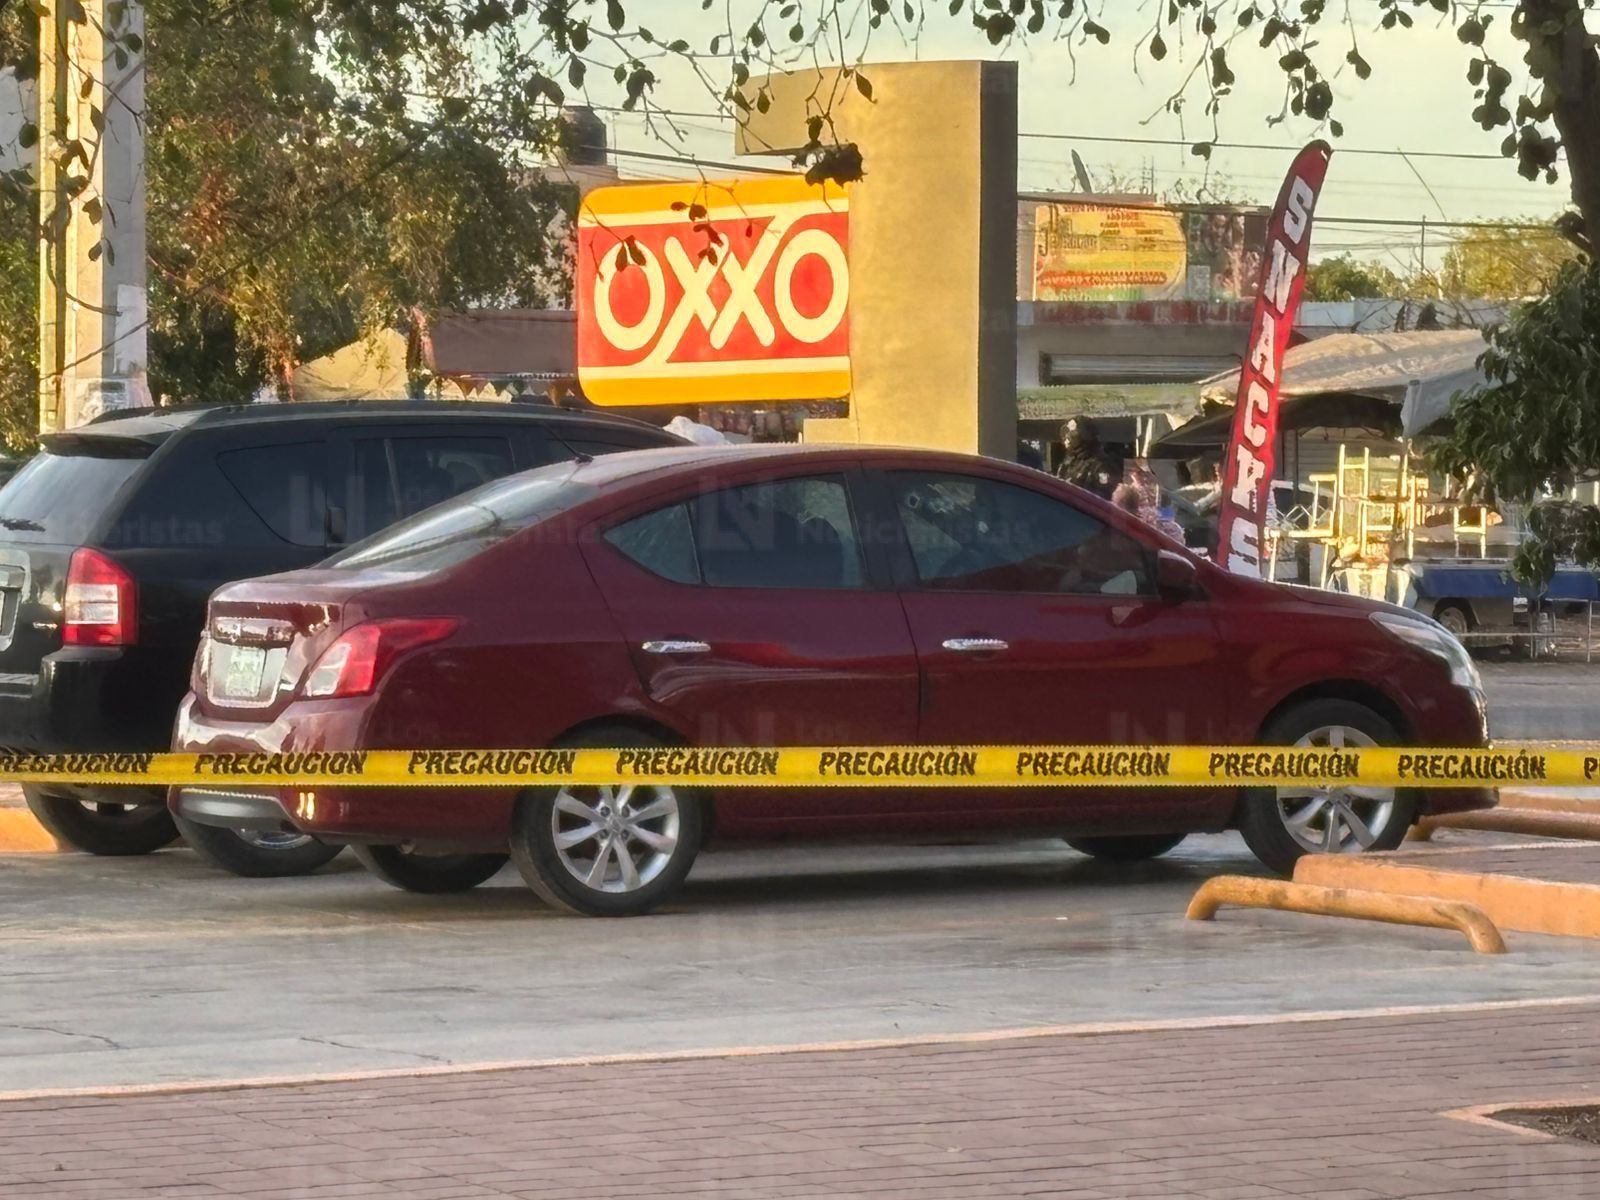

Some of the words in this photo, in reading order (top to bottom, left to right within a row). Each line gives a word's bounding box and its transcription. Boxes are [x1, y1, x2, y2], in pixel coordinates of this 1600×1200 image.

[593, 221, 850, 362] OXXO
[1228, 175, 1314, 577] SNACKS
[0, 754, 152, 774] RECAUCION
[1397, 749, 1546, 779] PRECAUCIÓN
